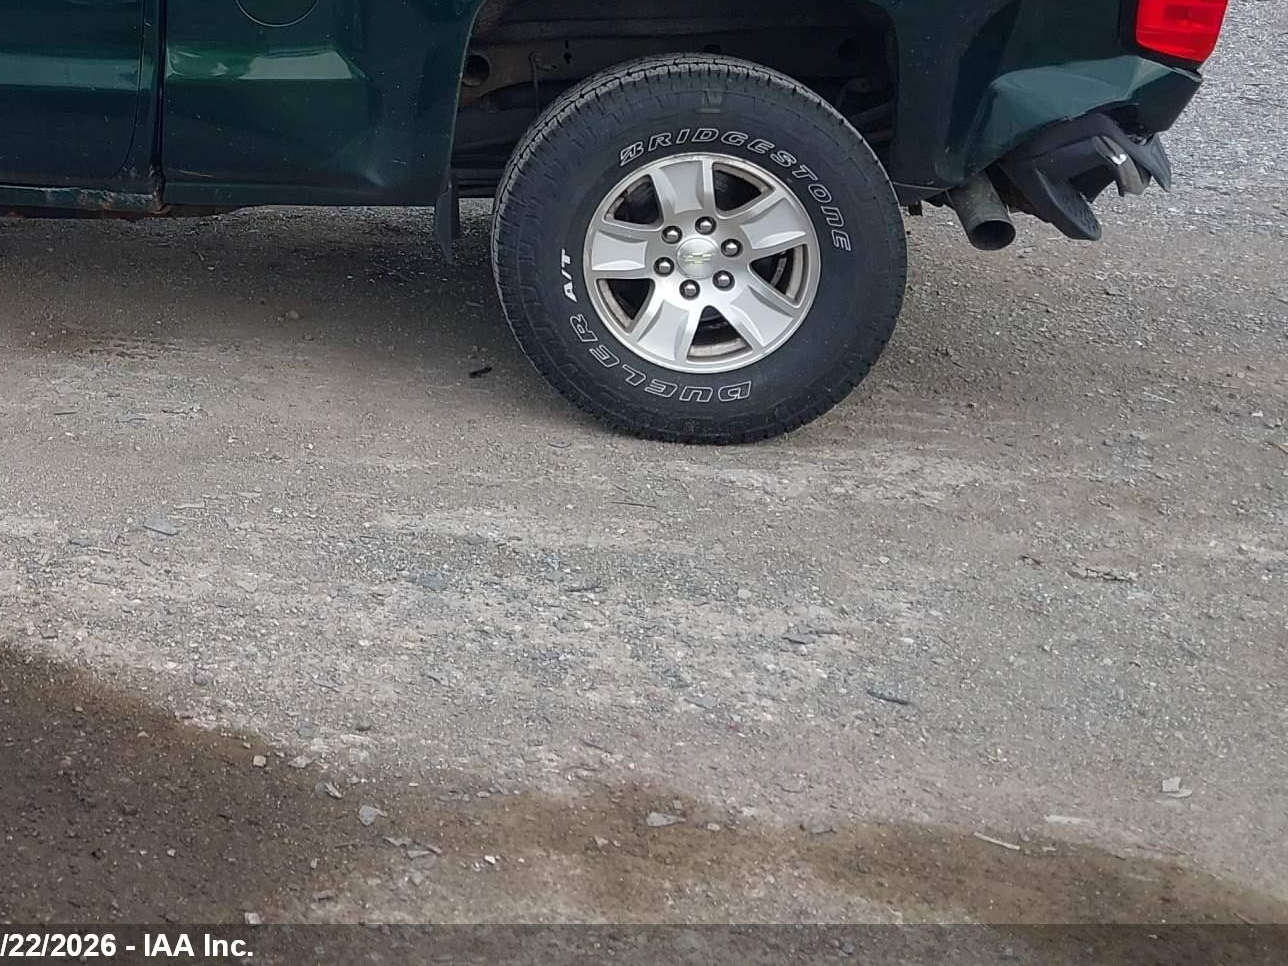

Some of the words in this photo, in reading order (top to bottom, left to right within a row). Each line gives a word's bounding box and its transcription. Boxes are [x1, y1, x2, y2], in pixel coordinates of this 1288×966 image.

[619, 128, 852, 252] BRIDGESTONE
[561, 248, 579, 303] A/T
[570, 314, 752, 403] DUELER
